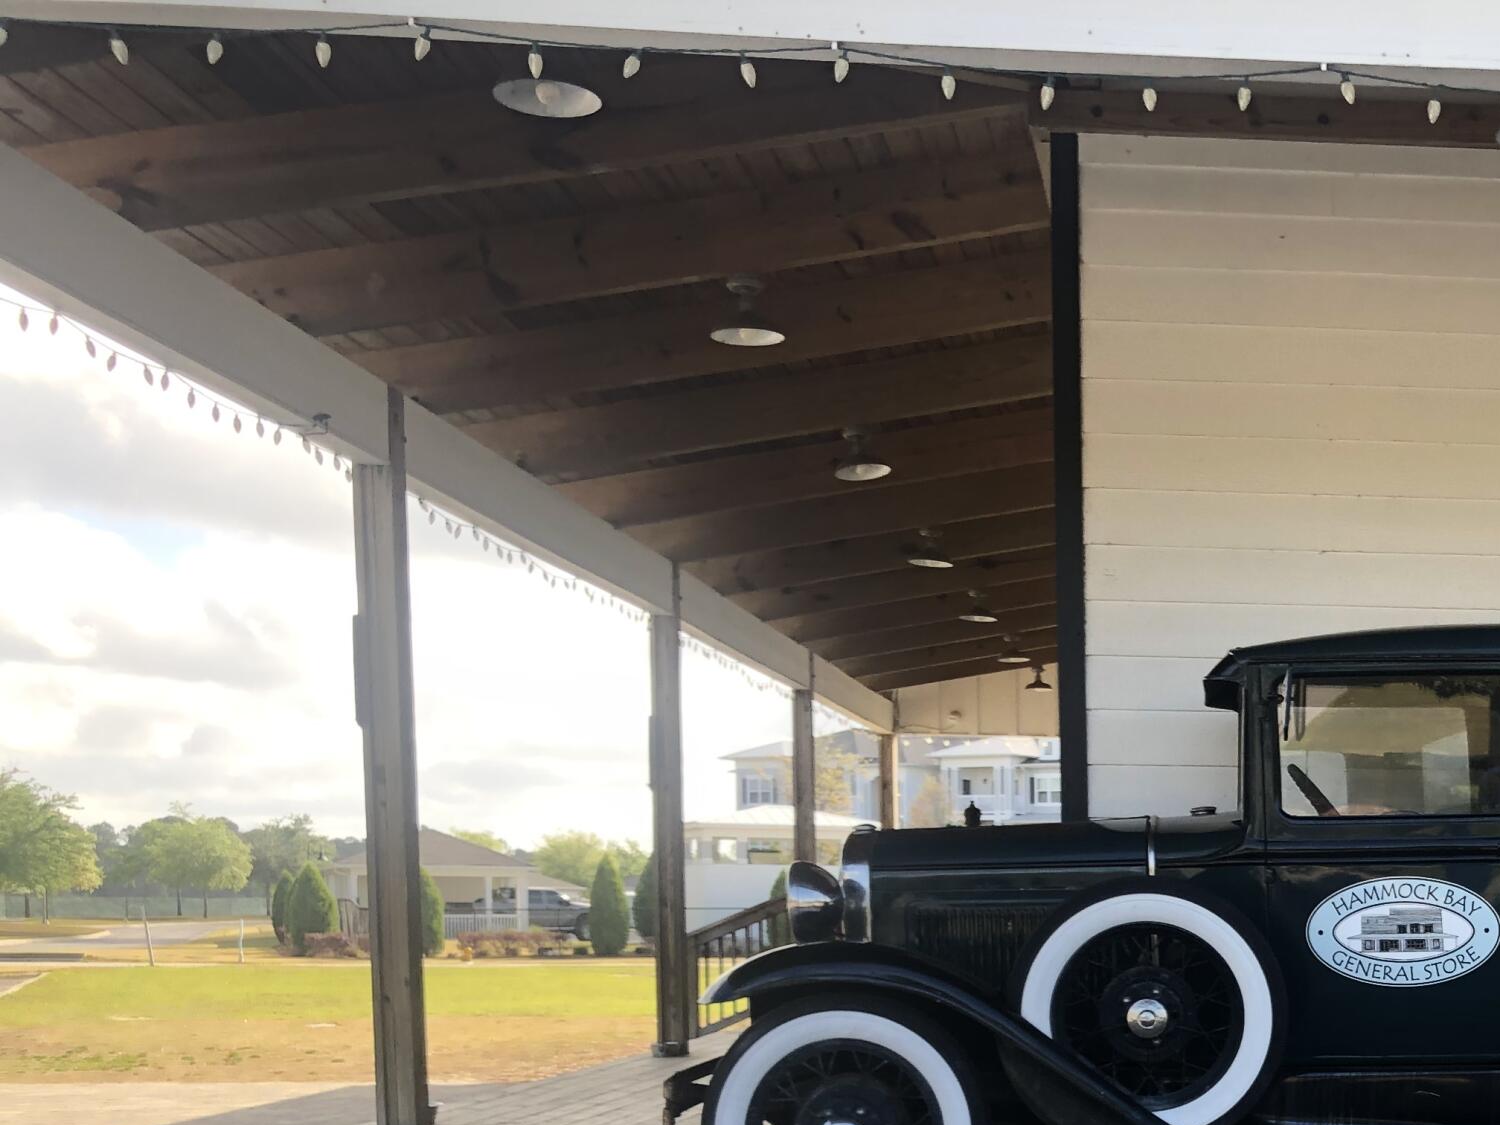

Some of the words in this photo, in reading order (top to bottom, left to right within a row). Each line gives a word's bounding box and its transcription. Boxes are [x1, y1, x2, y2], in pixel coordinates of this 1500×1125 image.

[1331, 882, 1439, 916] HAMMOCK
[1443, 888, 1482, 917] BAY
[1331, 950, 1420, 982] GENERAL
[1423, 945, 1481, 980] STORE
